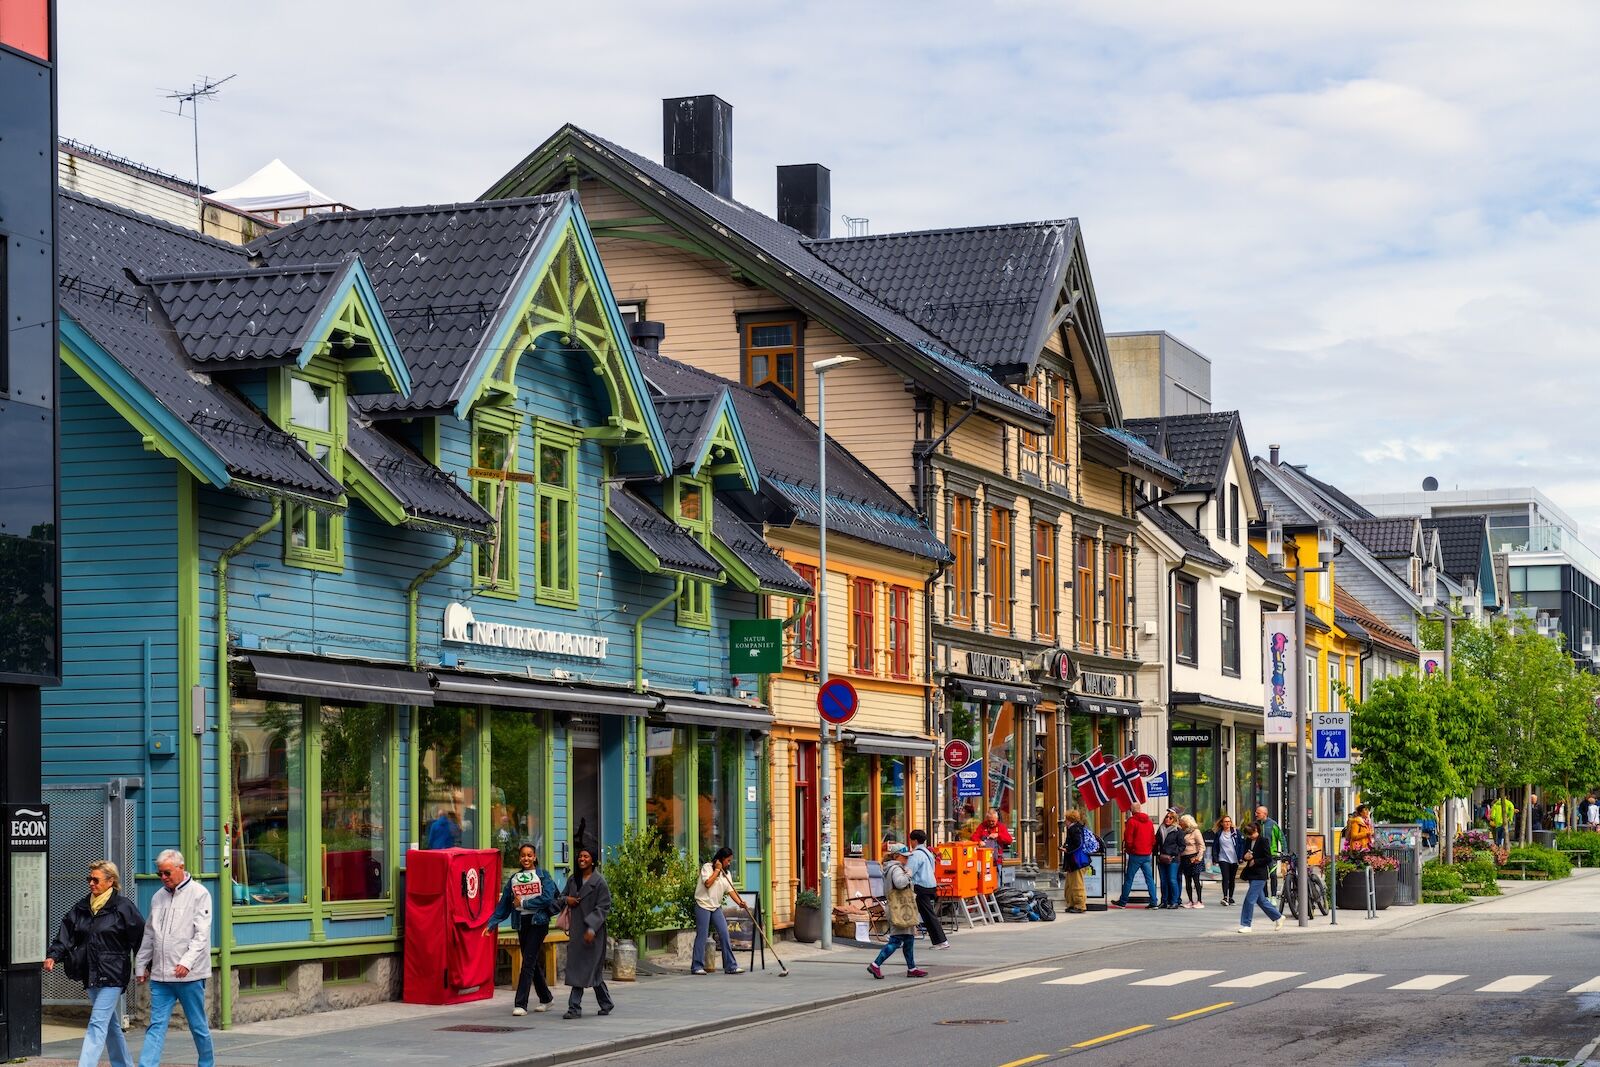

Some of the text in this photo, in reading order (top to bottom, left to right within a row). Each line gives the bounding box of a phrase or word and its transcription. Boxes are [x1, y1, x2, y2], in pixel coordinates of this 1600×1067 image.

[473, 621, 608, 659] NATURKOMPANIET
[969, 652, 992, 677] WAY
[1083, 672, 1100, 694] WAY
[1319, 715, 1344, 725] Sone
[11, 821, 47, 836] EGON
